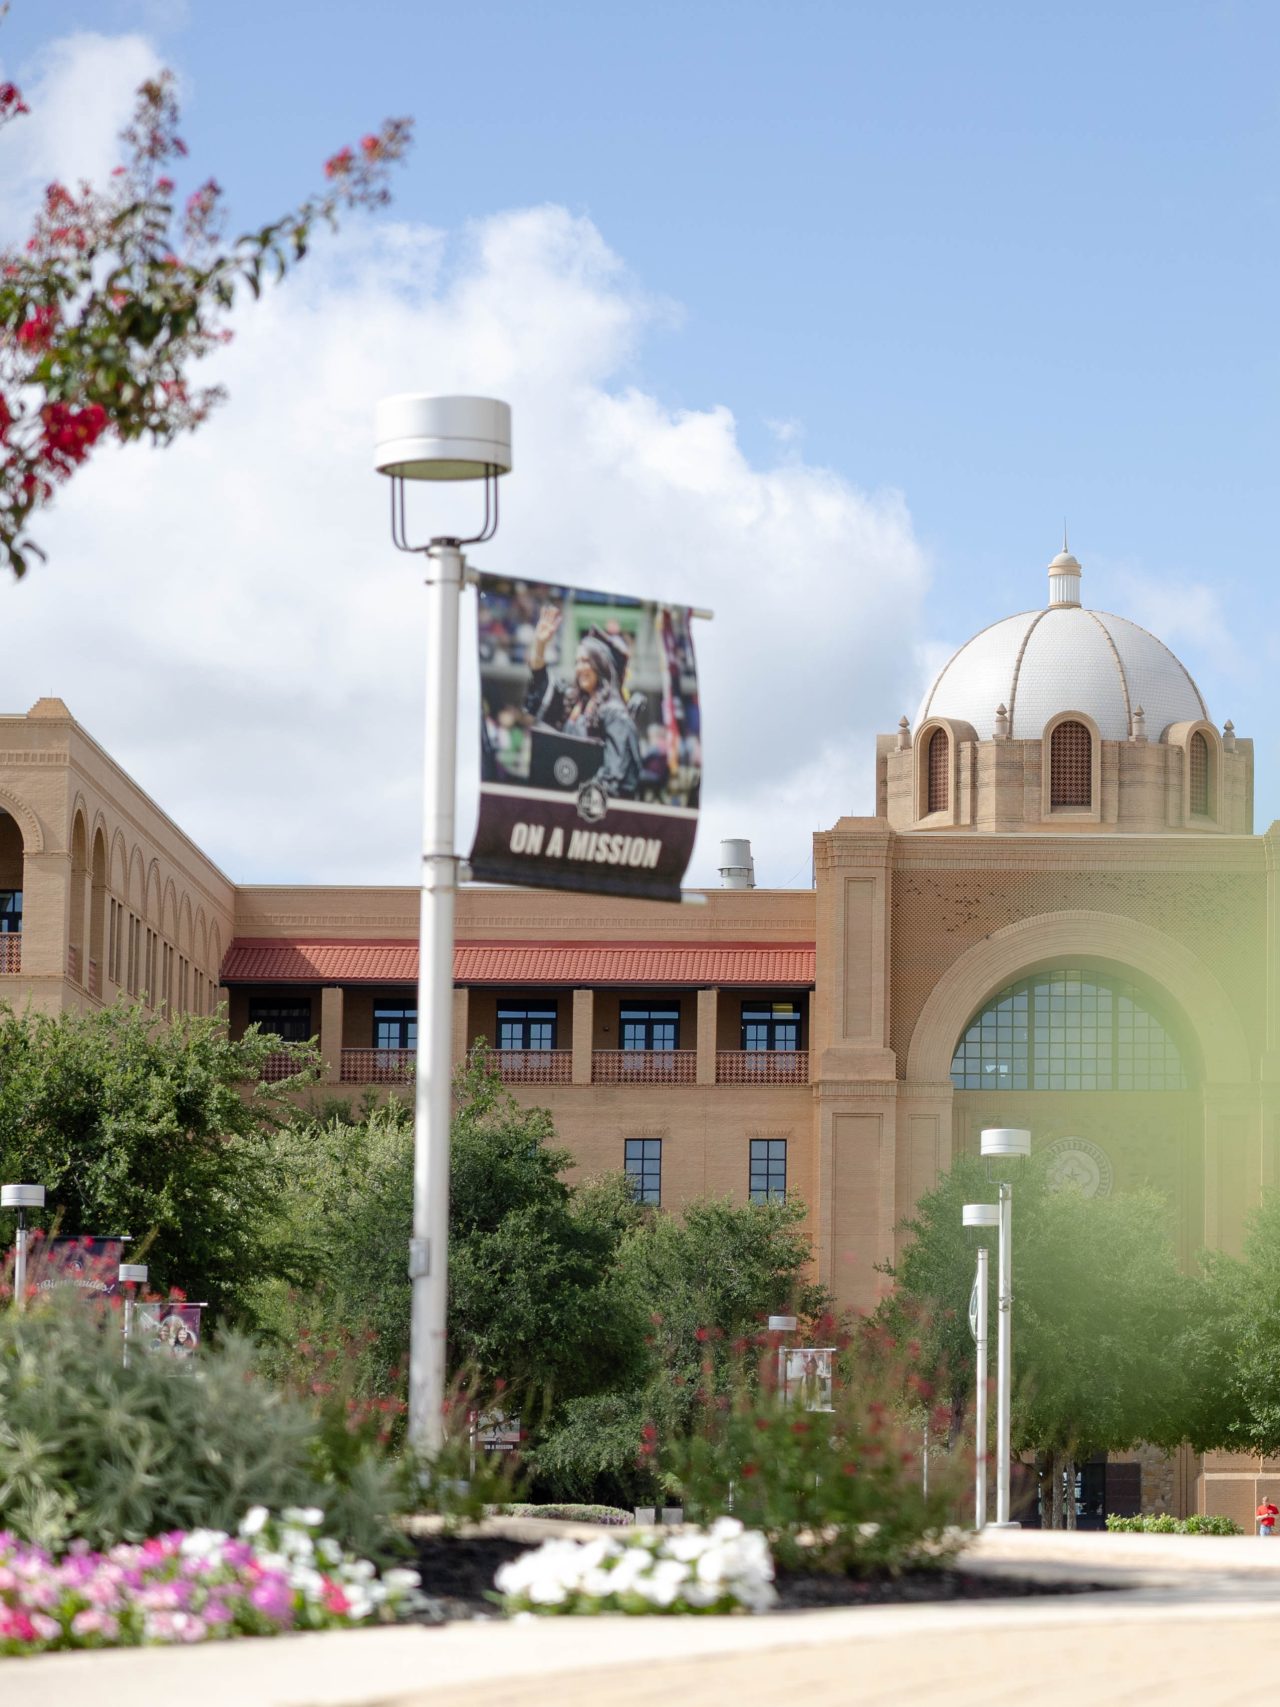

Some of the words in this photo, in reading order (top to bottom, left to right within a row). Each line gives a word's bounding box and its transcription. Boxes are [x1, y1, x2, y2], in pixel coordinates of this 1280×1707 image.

[509, 822, 545, 855] ON
[545, 827, 564, 858] A
[567, 829, 662, 869] MISSION
